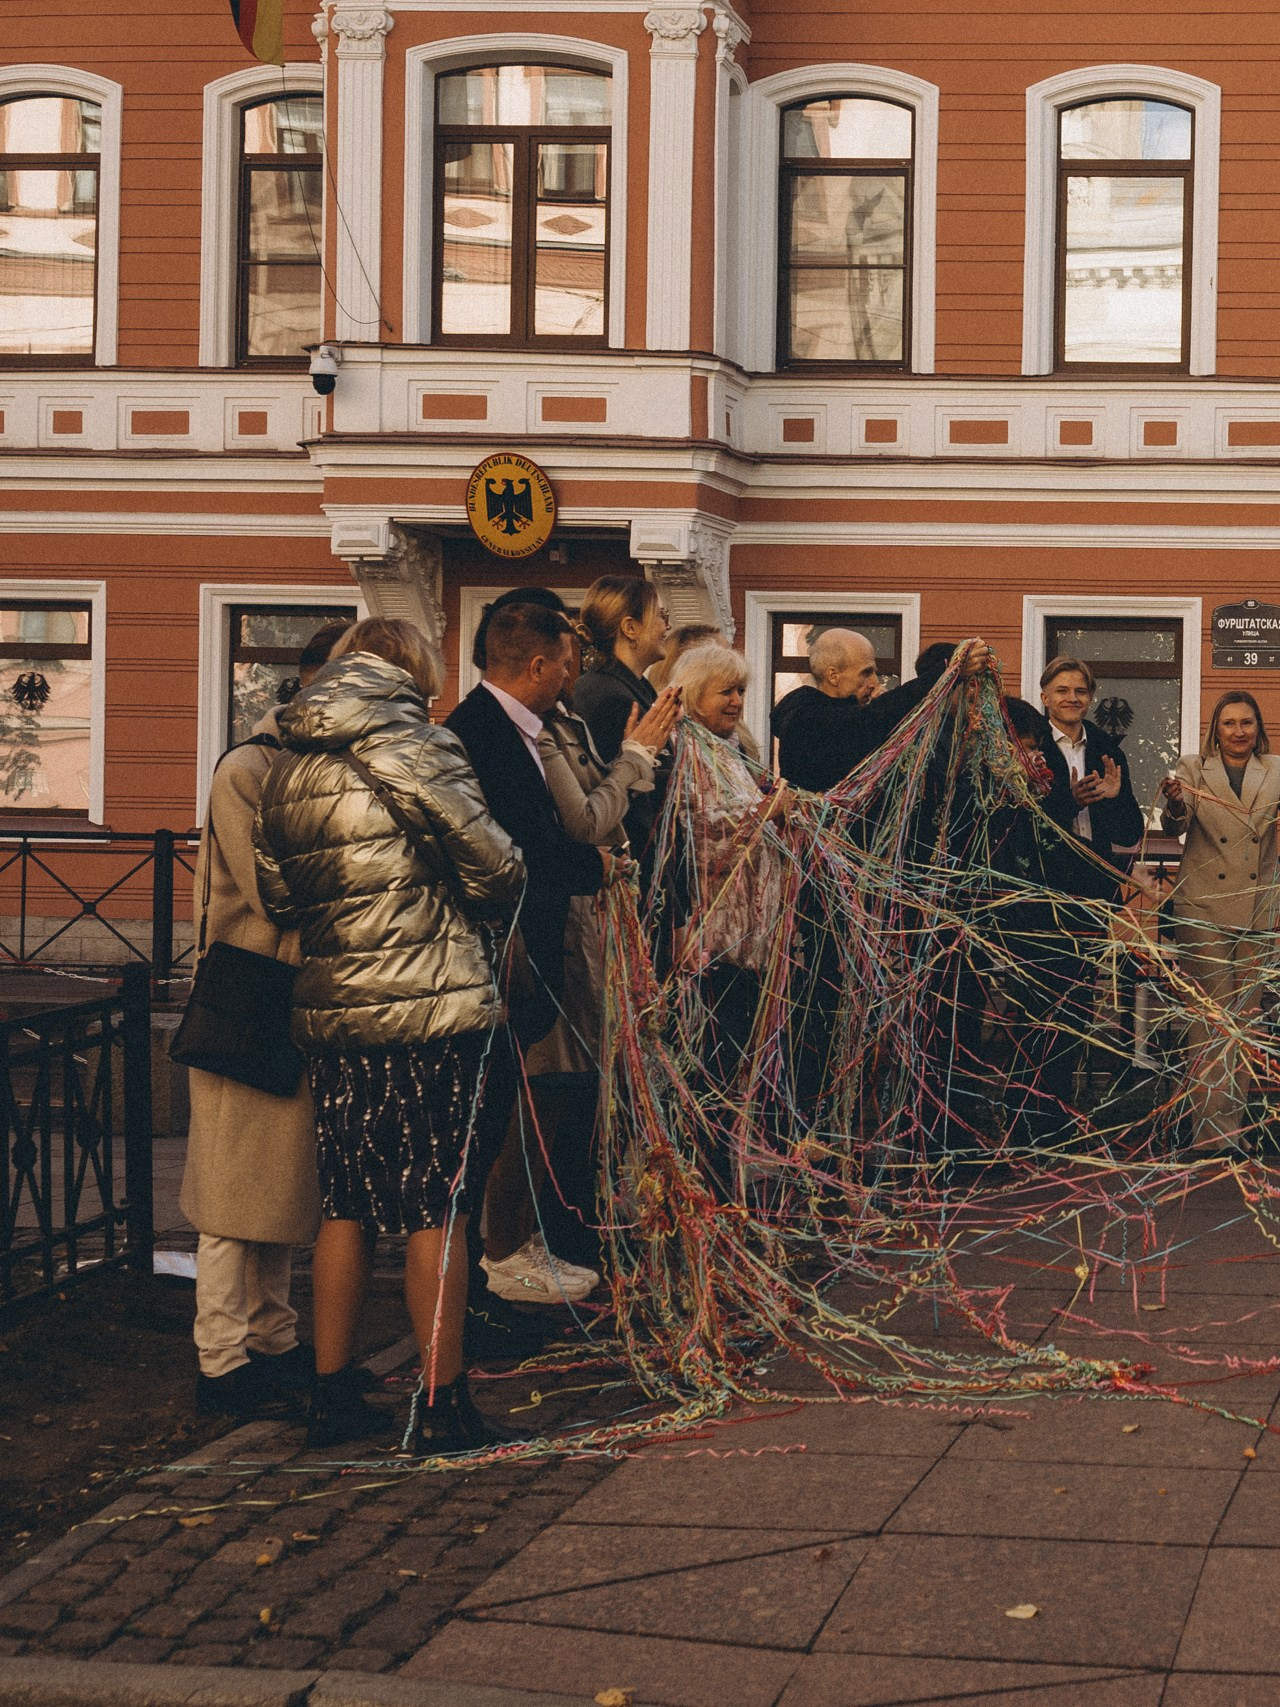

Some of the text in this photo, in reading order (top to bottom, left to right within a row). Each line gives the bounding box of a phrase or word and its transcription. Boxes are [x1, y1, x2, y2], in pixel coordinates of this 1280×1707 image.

[469, 456, 553, 513] BUNDESREPUBLIK DEUTSCHLAND
[481, 535, 544, 556] GENERALKONSULAT
[1244, 652, 1258, 665] 39
